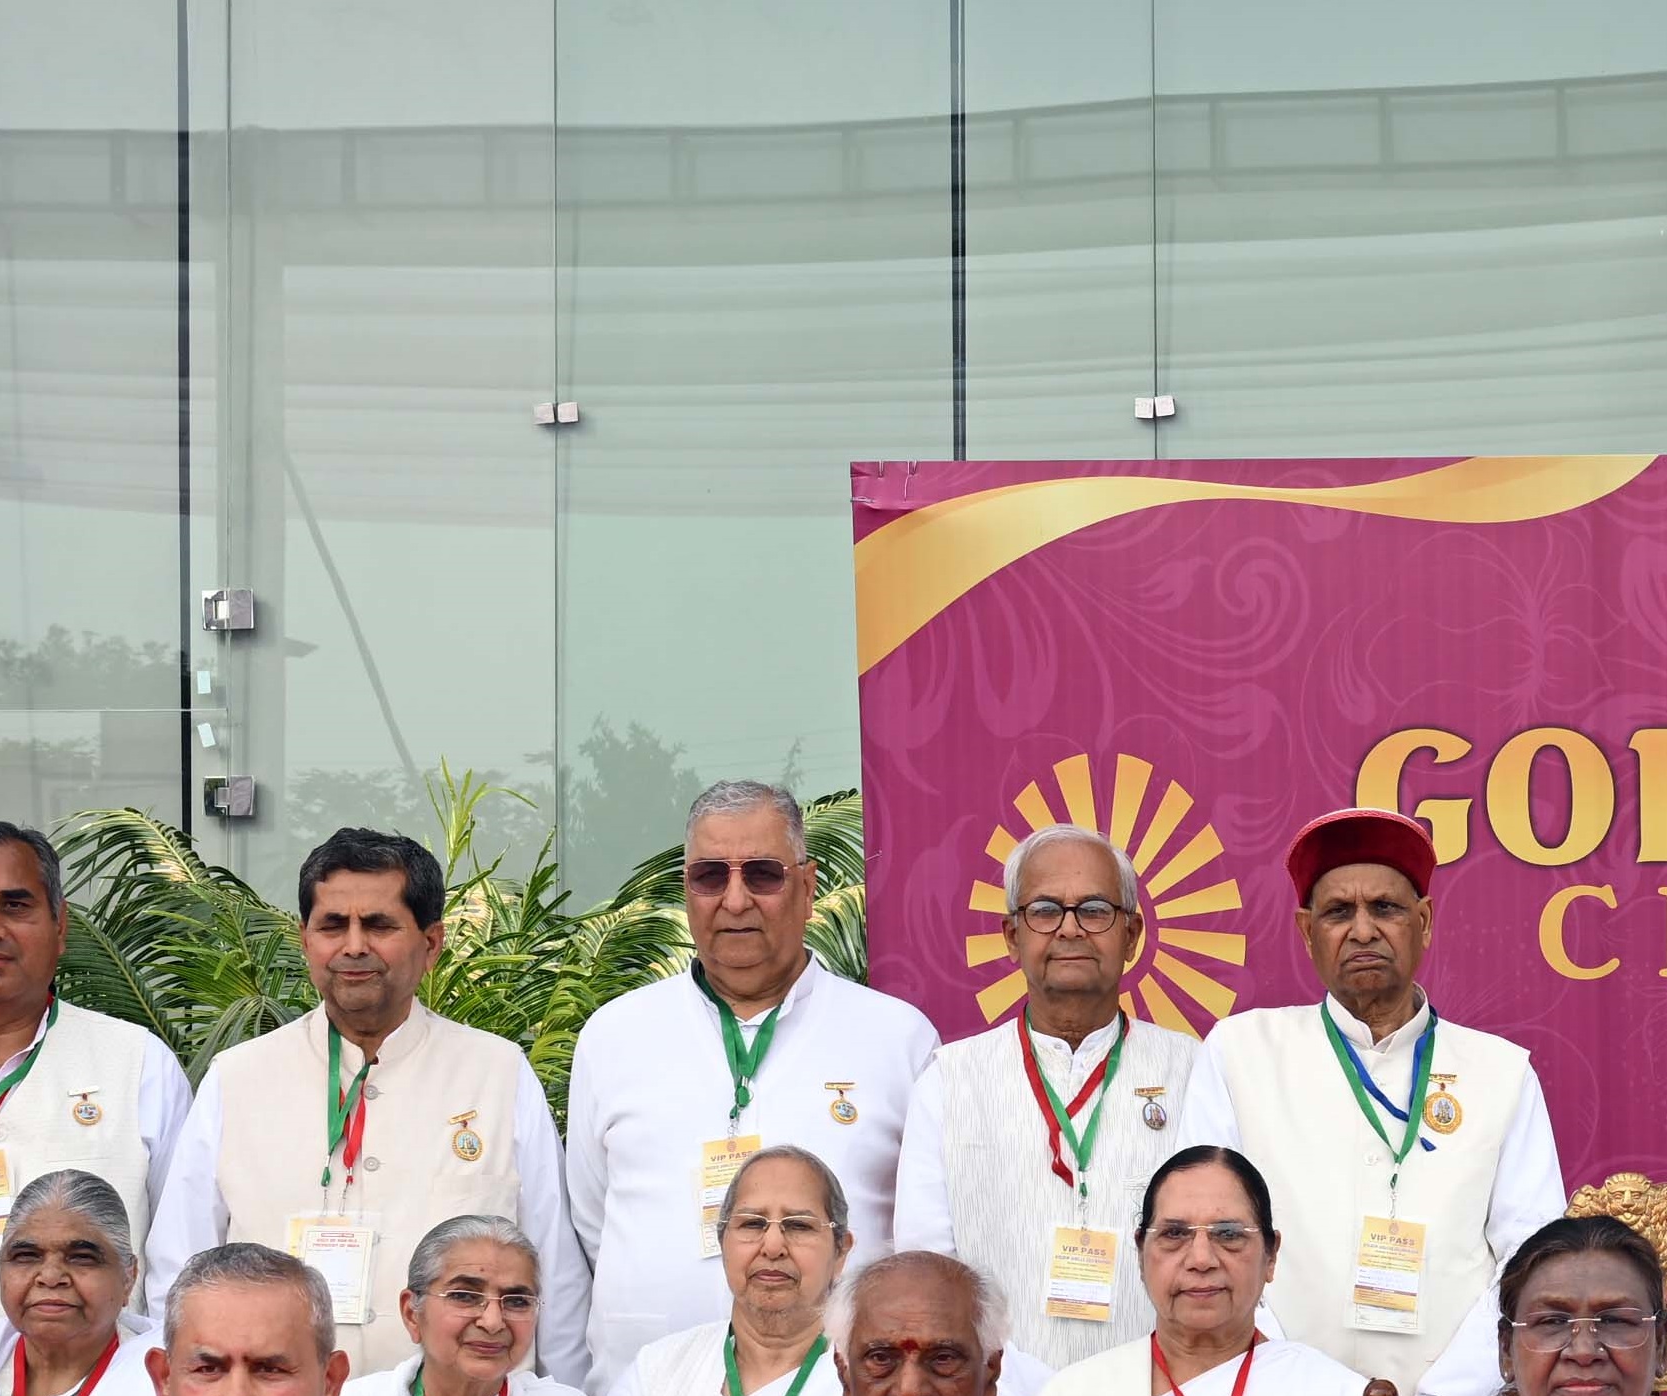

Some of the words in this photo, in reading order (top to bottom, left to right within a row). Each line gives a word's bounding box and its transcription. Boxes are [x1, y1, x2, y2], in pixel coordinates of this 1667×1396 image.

[710, 1154, 727, 1162] VIP
[1370, 1232, 1387, 1242] VIP
[1389, 1236, 1415, 1246] PASS
[1062, 1245, 1079, 1253] VIP
[1080, 1246, 1107, 1256] PASS
